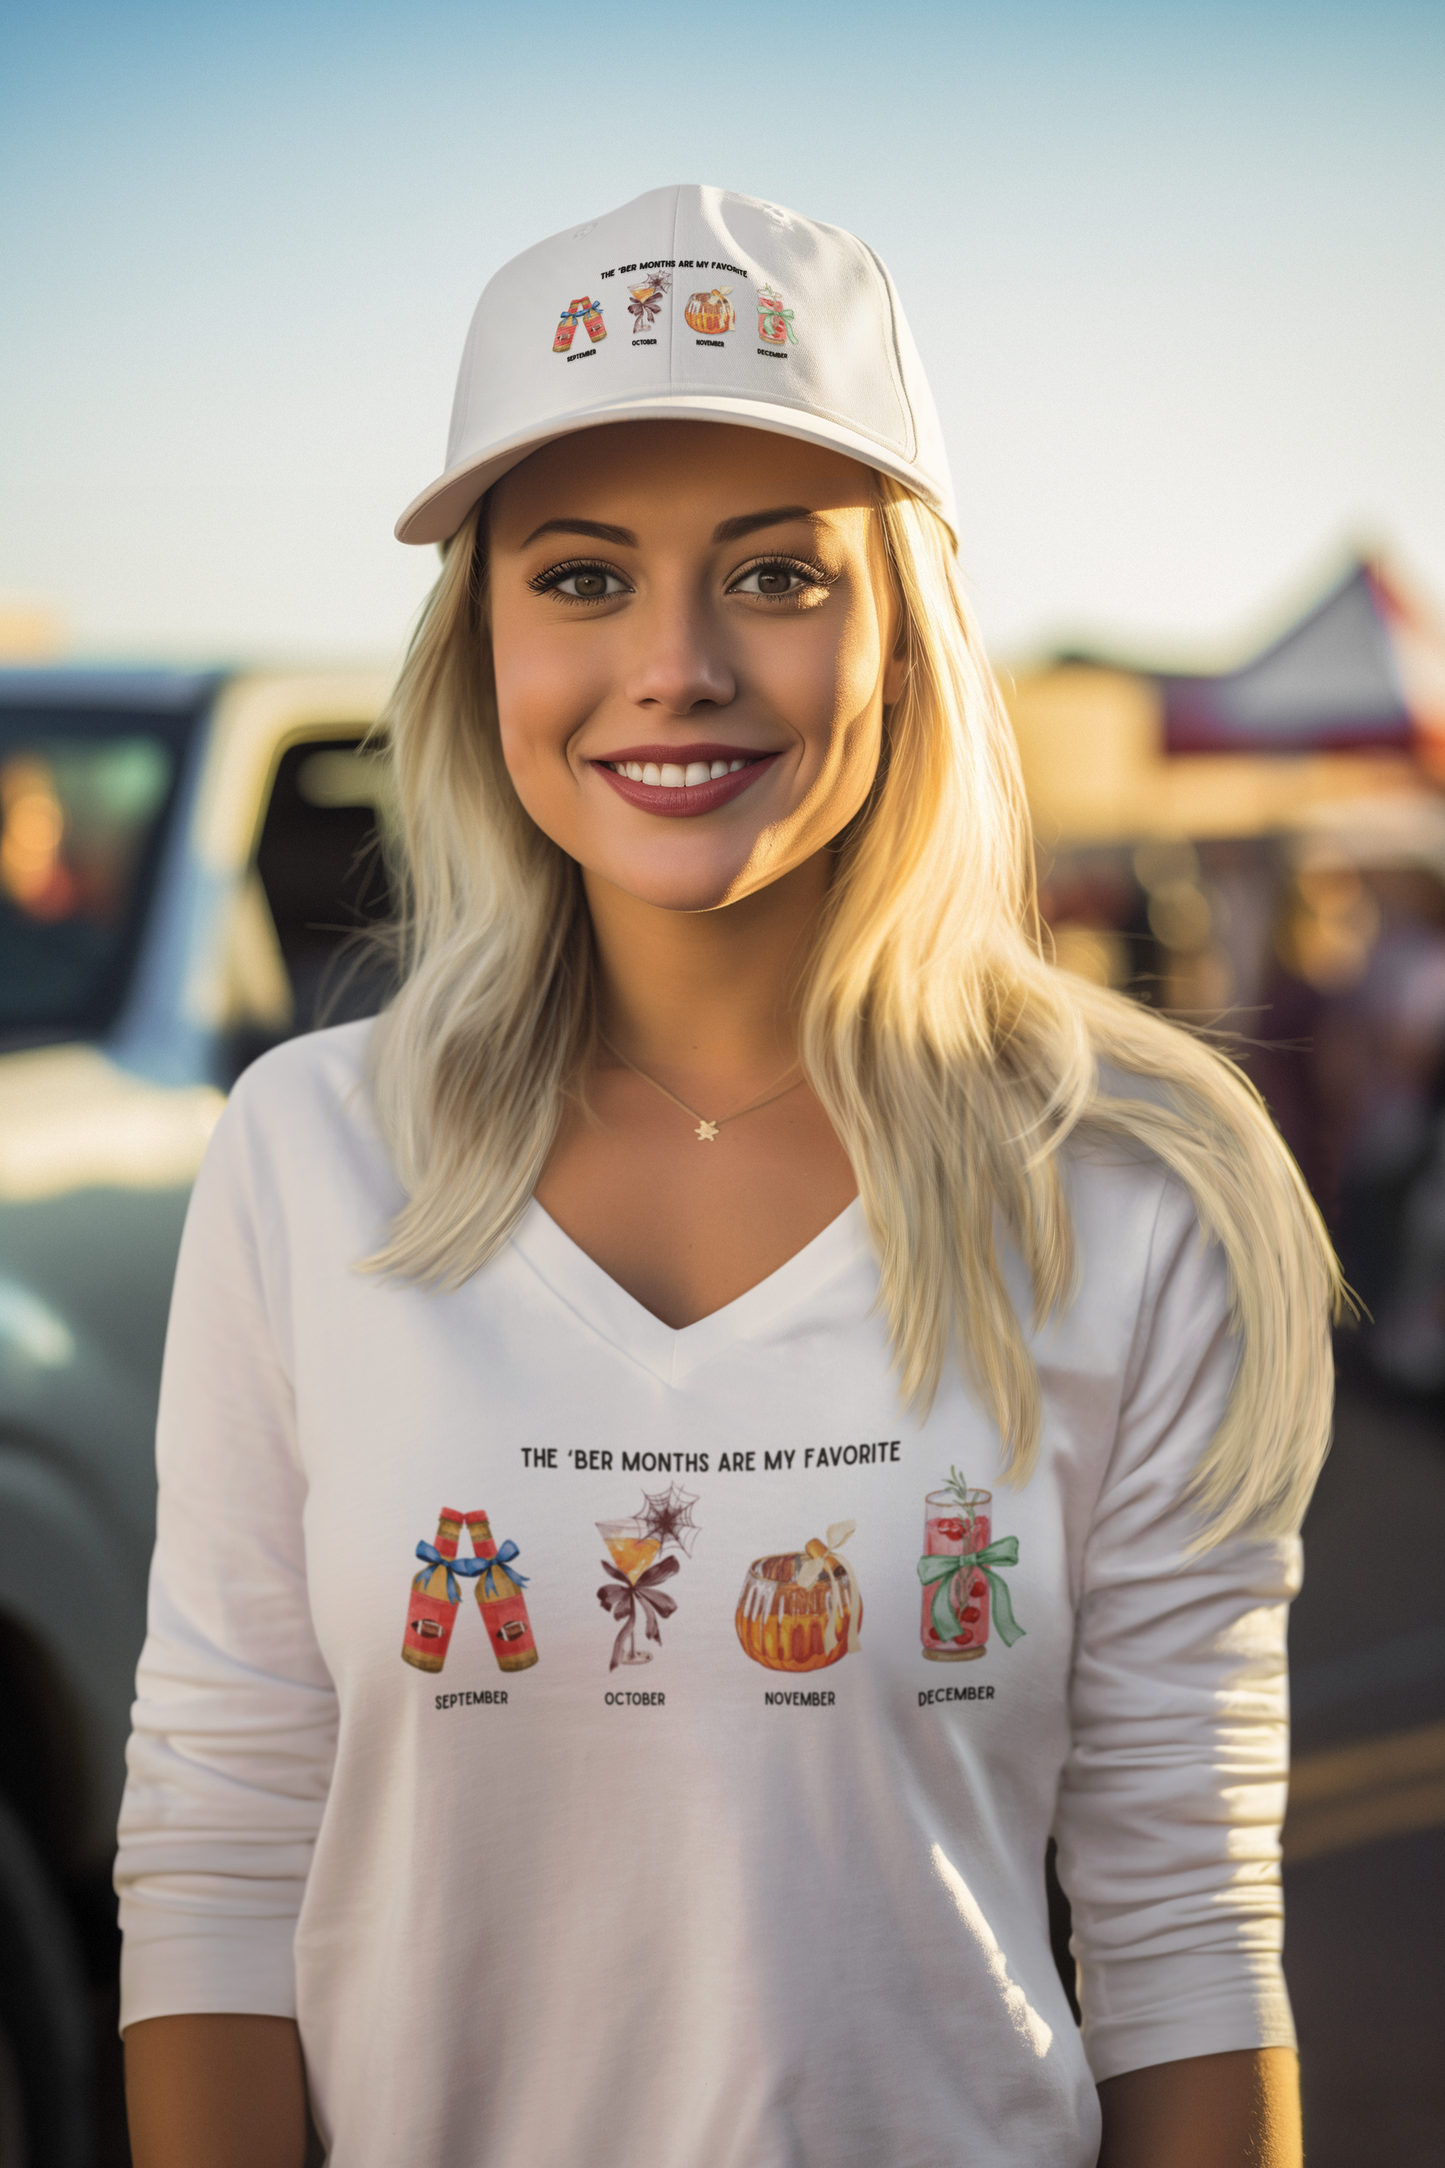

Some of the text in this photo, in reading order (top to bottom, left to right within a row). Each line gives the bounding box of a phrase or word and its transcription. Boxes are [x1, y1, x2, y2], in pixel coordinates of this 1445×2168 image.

[600, 268, 615, 279] THE
[639, 260, 675, 269] MONTHS
[678, 260, 694, 268] ARE
[711, 261, 748, 278] FAVORITE
[566, 348, 597, 362] SEPTEMBER
[757, 348, 788, 359] DECEMBER
[521, 1447, 558, 1468] THE
[622, 1451, 709, 1472] MONTHS
[718, 1451, 756, 1472] ARE
[764, 1449, 796, 1470] MY
[804, 1440, 901, 1469] FAVORITE
[435, 1690, 508, 1709] SEPTEMBER
[604, 1692, 665, 1706] OCTOBER
[764, 1691, 836, 1706] NOVEMBER
[917, 1686, 996, 1707] DECEMBER
